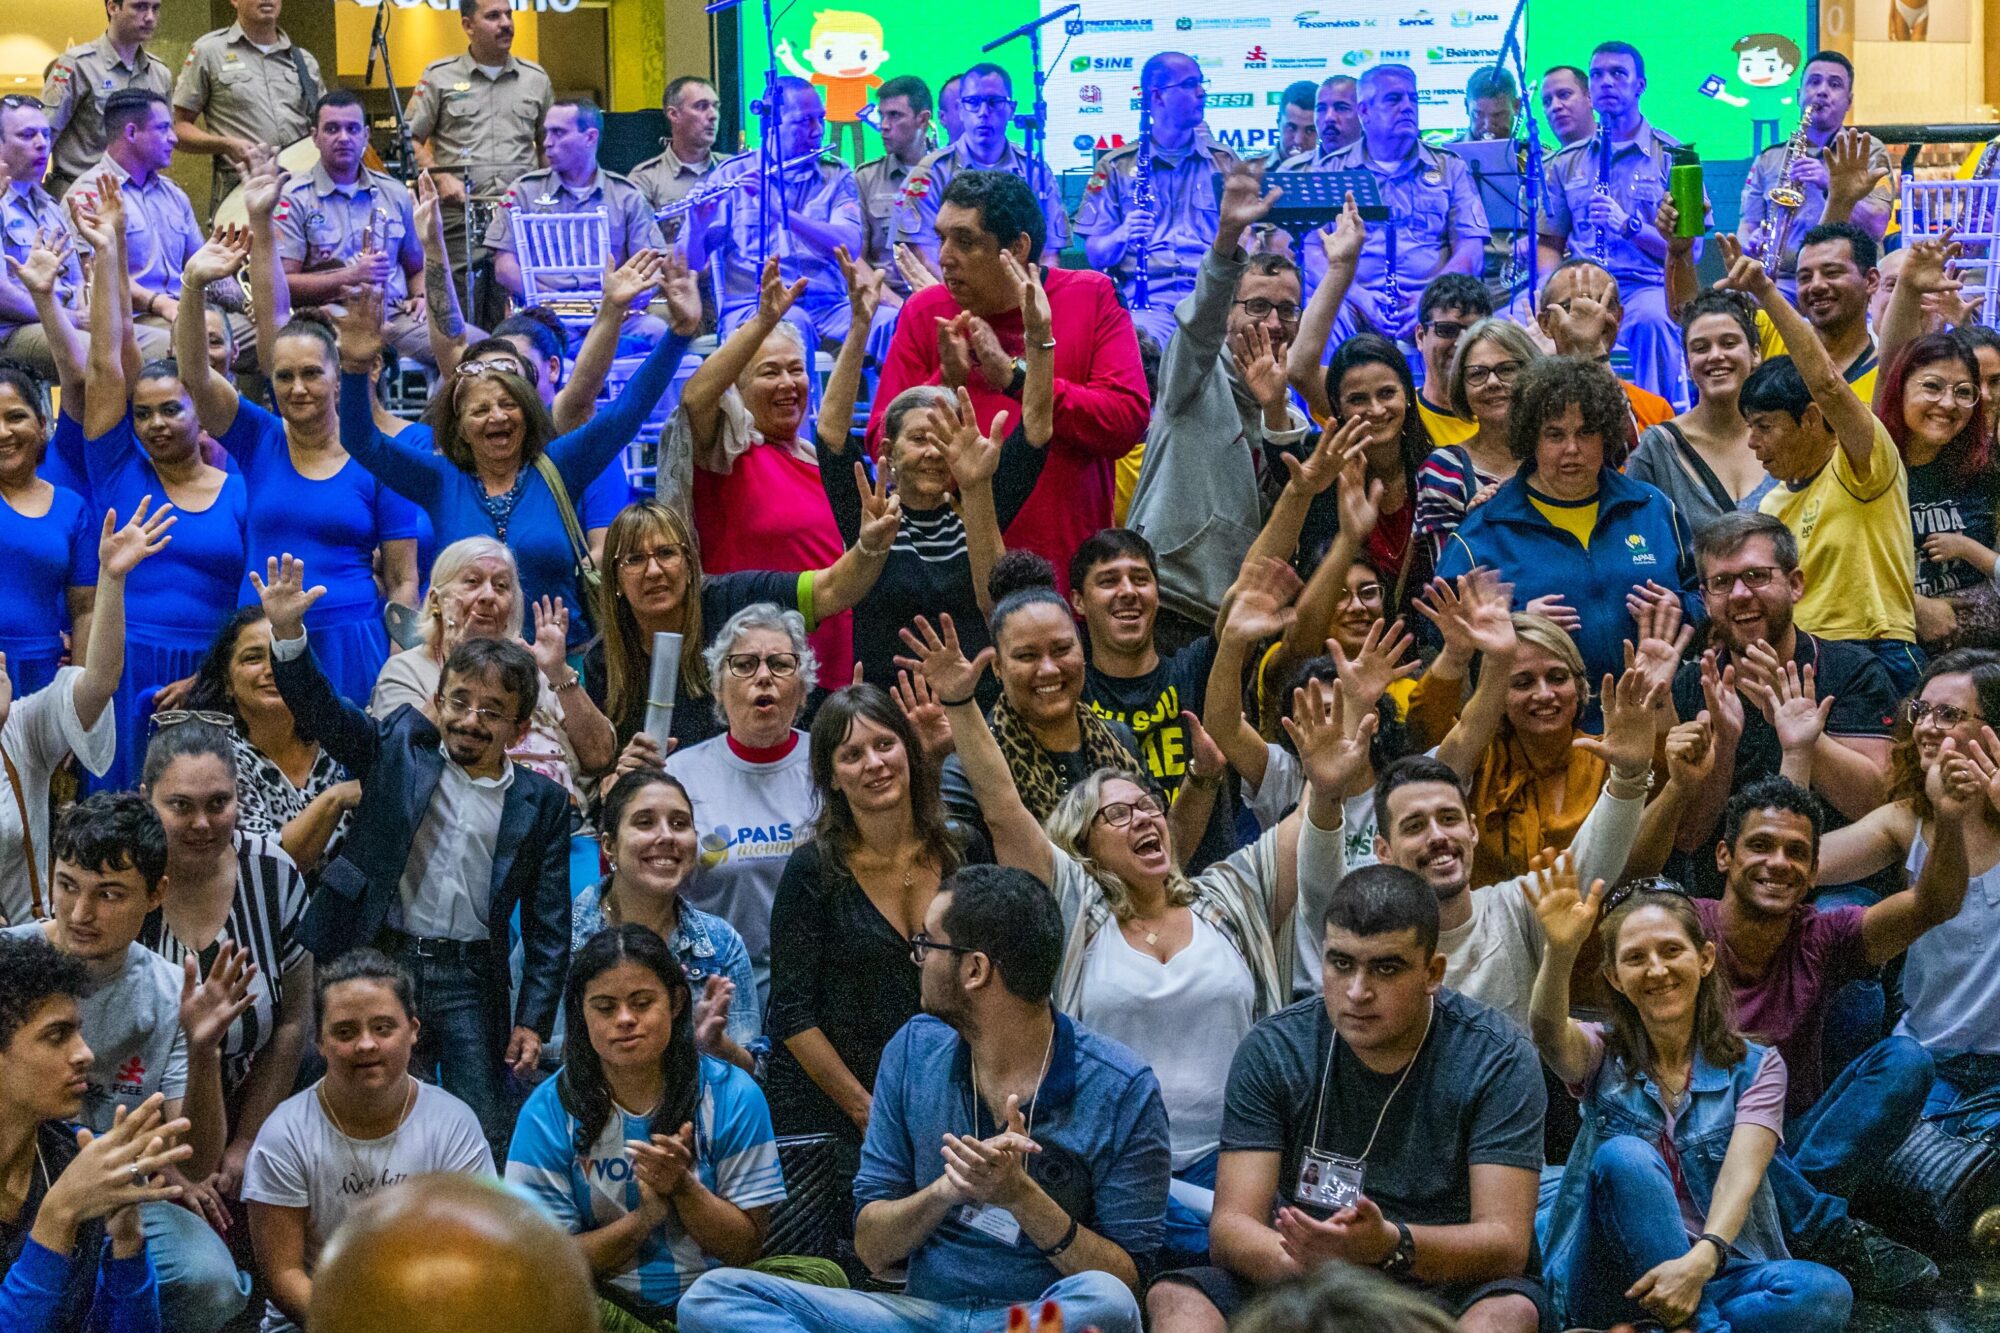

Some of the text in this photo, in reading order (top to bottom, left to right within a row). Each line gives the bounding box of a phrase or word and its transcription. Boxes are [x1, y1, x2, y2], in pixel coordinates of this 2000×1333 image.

[1094, 57, 1134, 69] SINE
[1912, 507, 1968, 535] VIDA
[1632, 553, 1657, 562] APAE
[737, 823, 794, 844] PAIS
[112, 1083, 144, 1096] FCEE
